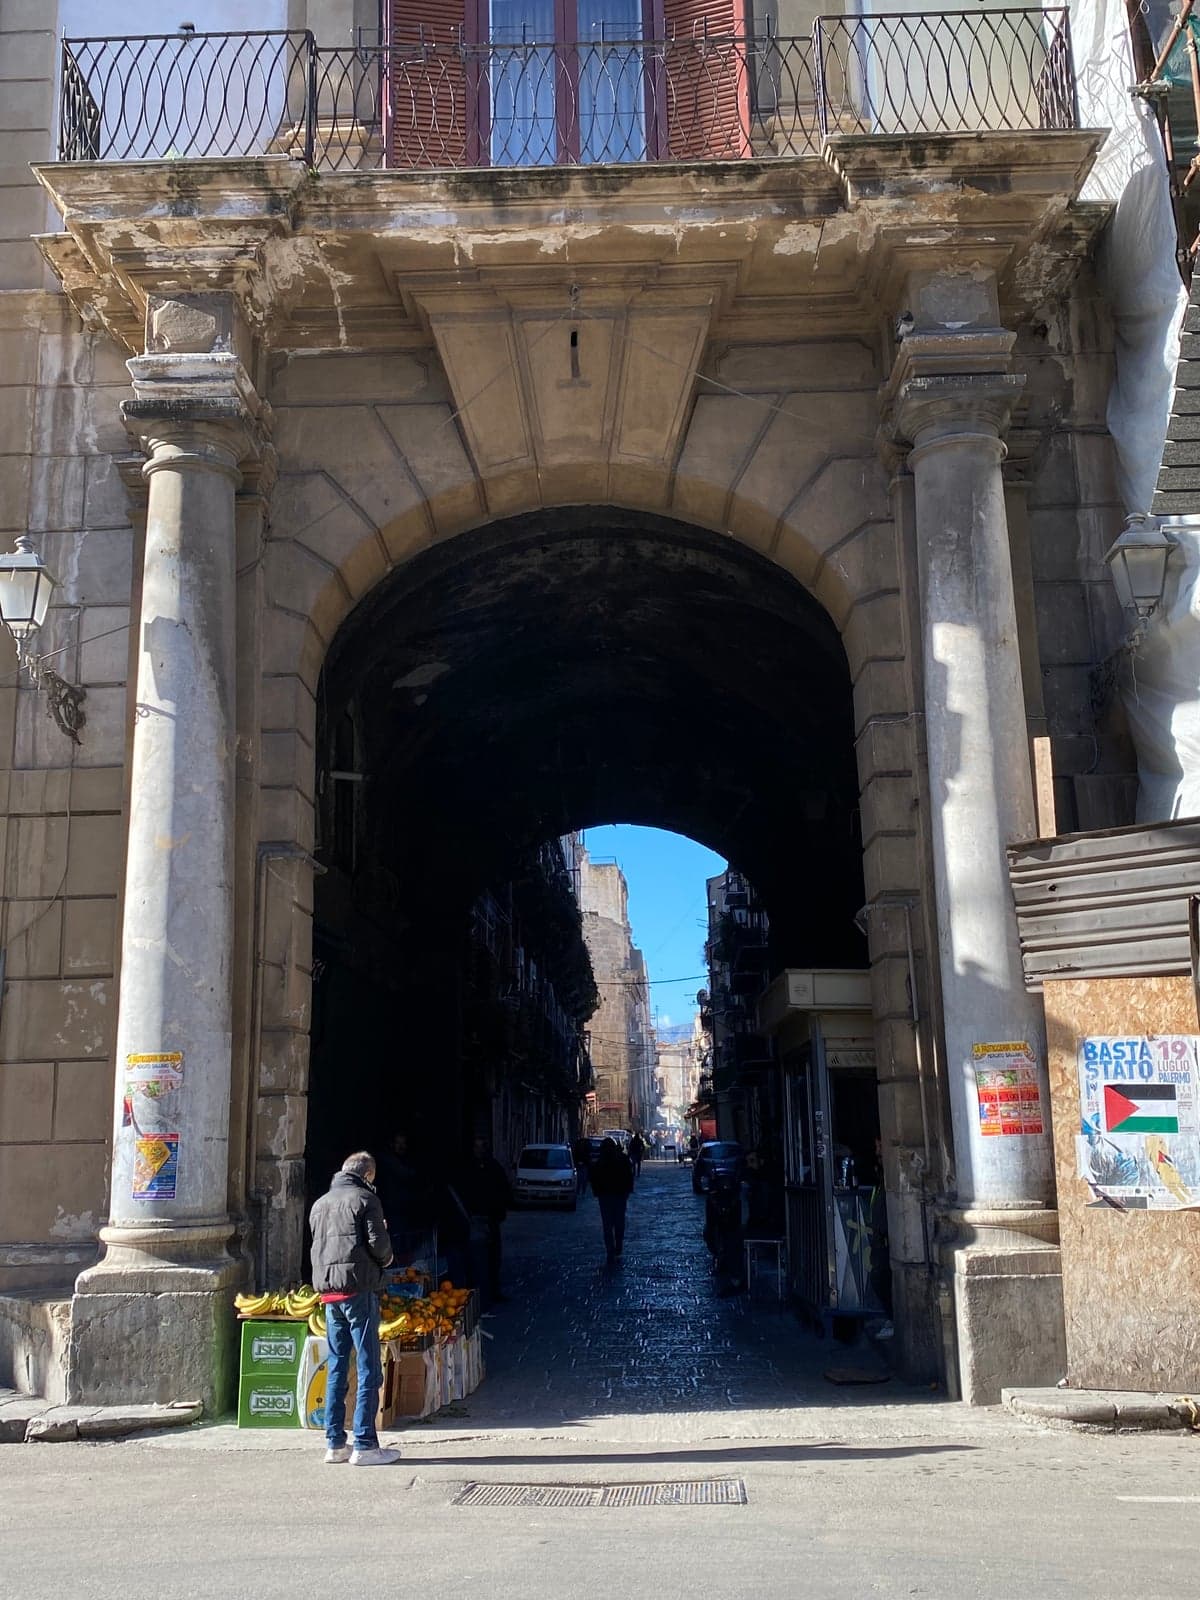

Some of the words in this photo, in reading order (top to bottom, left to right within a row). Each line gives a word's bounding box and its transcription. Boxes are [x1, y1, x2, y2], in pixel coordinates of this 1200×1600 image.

[1083, 1041, 1152, 1060] BASTA
[1157, 1040, 1188, 1060] 19
[1084, 1060, 1153, 1080] STATO
[1158, 1060, 1190, 1071] LUGLIO
[1158, 1071, 1190, 1084] PALERMO
[254, 1344, 293, 1356] FORST
[252, 1396, 291, 1409] FORST
